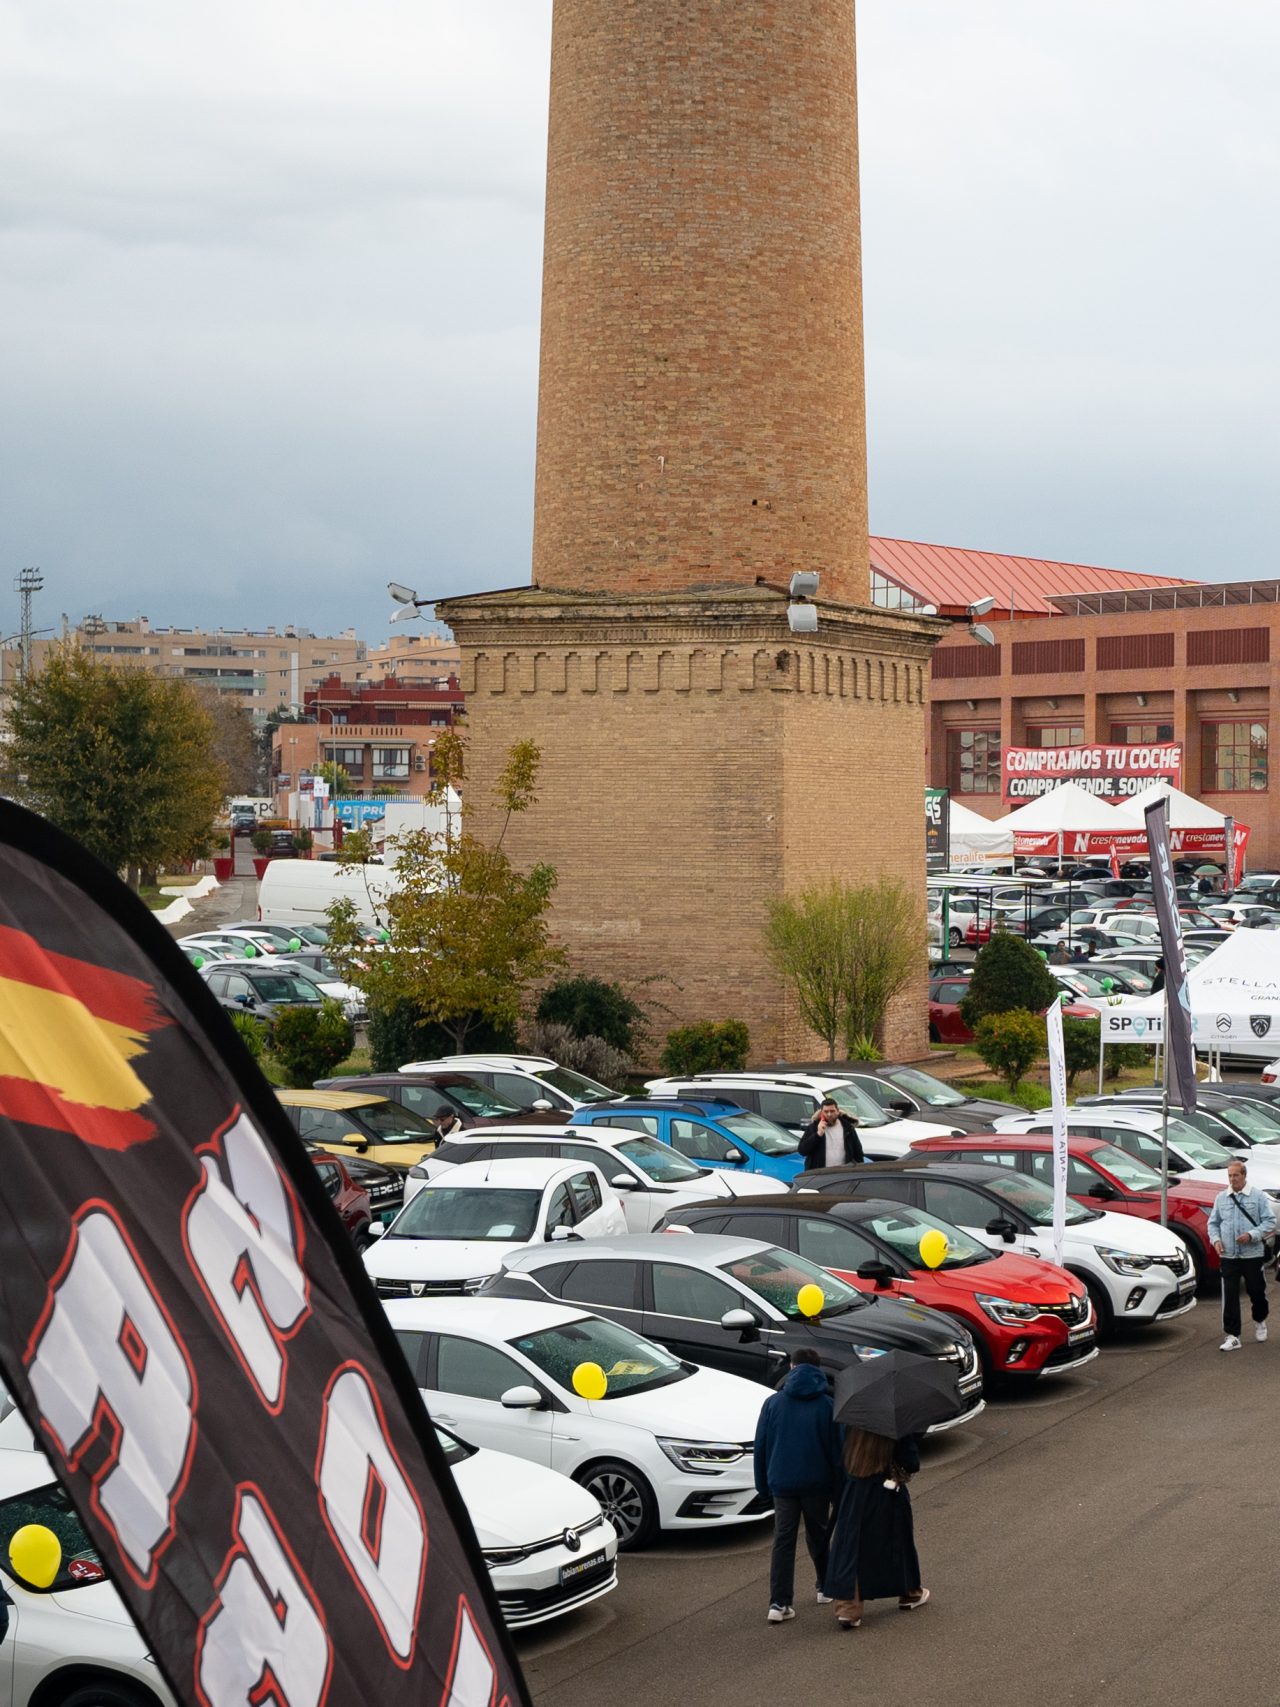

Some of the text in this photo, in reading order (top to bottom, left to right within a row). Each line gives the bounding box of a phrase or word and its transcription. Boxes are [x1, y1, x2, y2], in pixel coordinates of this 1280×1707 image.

[1007, 747, 1181, 771] COMPRAMOS TU COCHE
[1186, 832, 1226, 842] crestanev
[562, 1554, 605, 1579] fabianarenas.es
